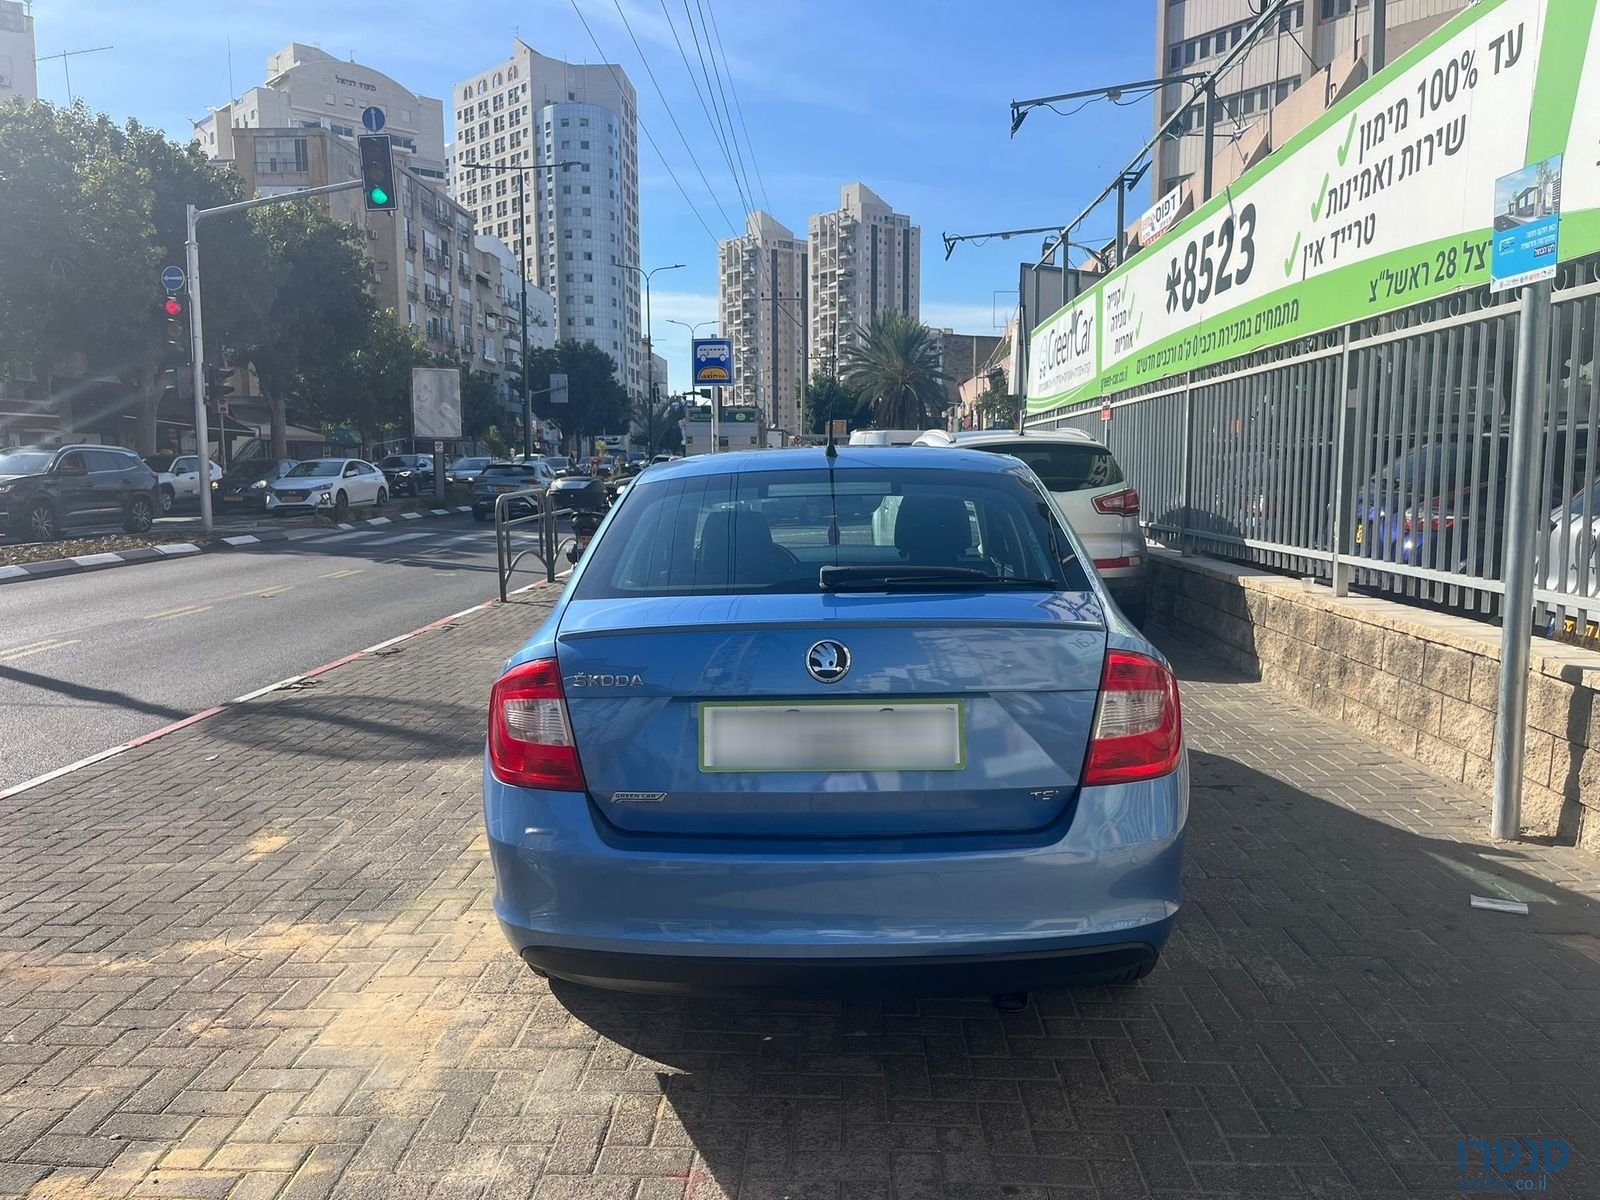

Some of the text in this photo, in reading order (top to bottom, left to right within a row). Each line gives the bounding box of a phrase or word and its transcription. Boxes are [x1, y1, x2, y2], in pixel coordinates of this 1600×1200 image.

[1359, 22, 1524, 164] עד 100% מימון
[1326, 114, 1466, 219] שירות ואמינות
[1155, 194, 1176, 223] דפוס
[1302, 212, 1376, 280] טרייד אין
[1434, 246, 1457, 283] 28
[1369, 261, 1430, 303] ראשל"צ
[1110, 309, 1127, 332] מכירה
[1254, 298, 1299, 335] מתמחים
[1074, 309, 1094, 357] Car
[1114, 330, 1134, 355] אחריות
[1192, 333, 1198, 358] 0
[1200, 331, 1216, 354] רכבי
[1217, 317, 1251, 349] במכירת
[1136, 355, 1156, 375] חדשים
[1157, 342, 1177, 368] ורכבים
[573, 672, 645, 687] ŠKODA
